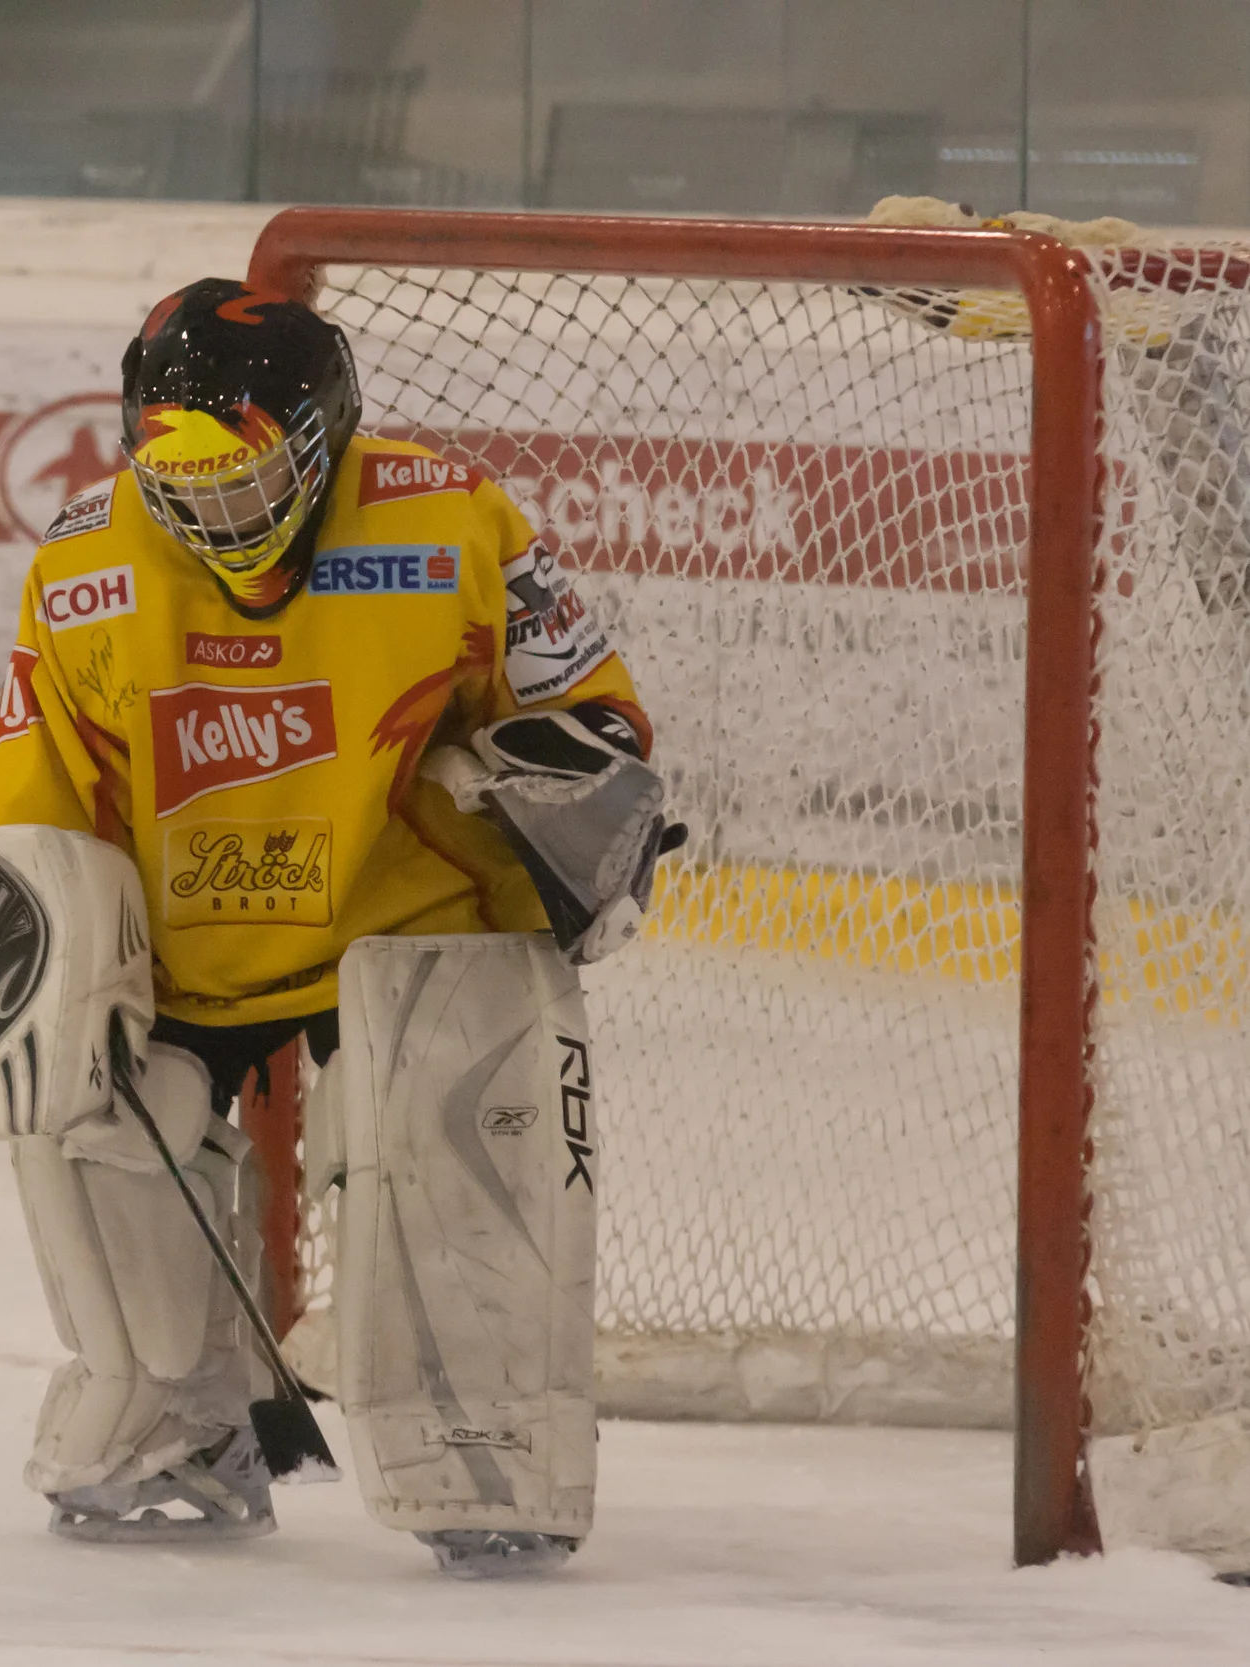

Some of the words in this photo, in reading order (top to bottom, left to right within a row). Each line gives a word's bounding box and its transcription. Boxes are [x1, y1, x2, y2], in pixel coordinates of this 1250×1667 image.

[311, 555, 421, 592] ERSTE
[193, 638, 246, 664] ASKÖ
[175, 699, 313, 773] Kelly's
[212, 896, 298, 911] BROT
